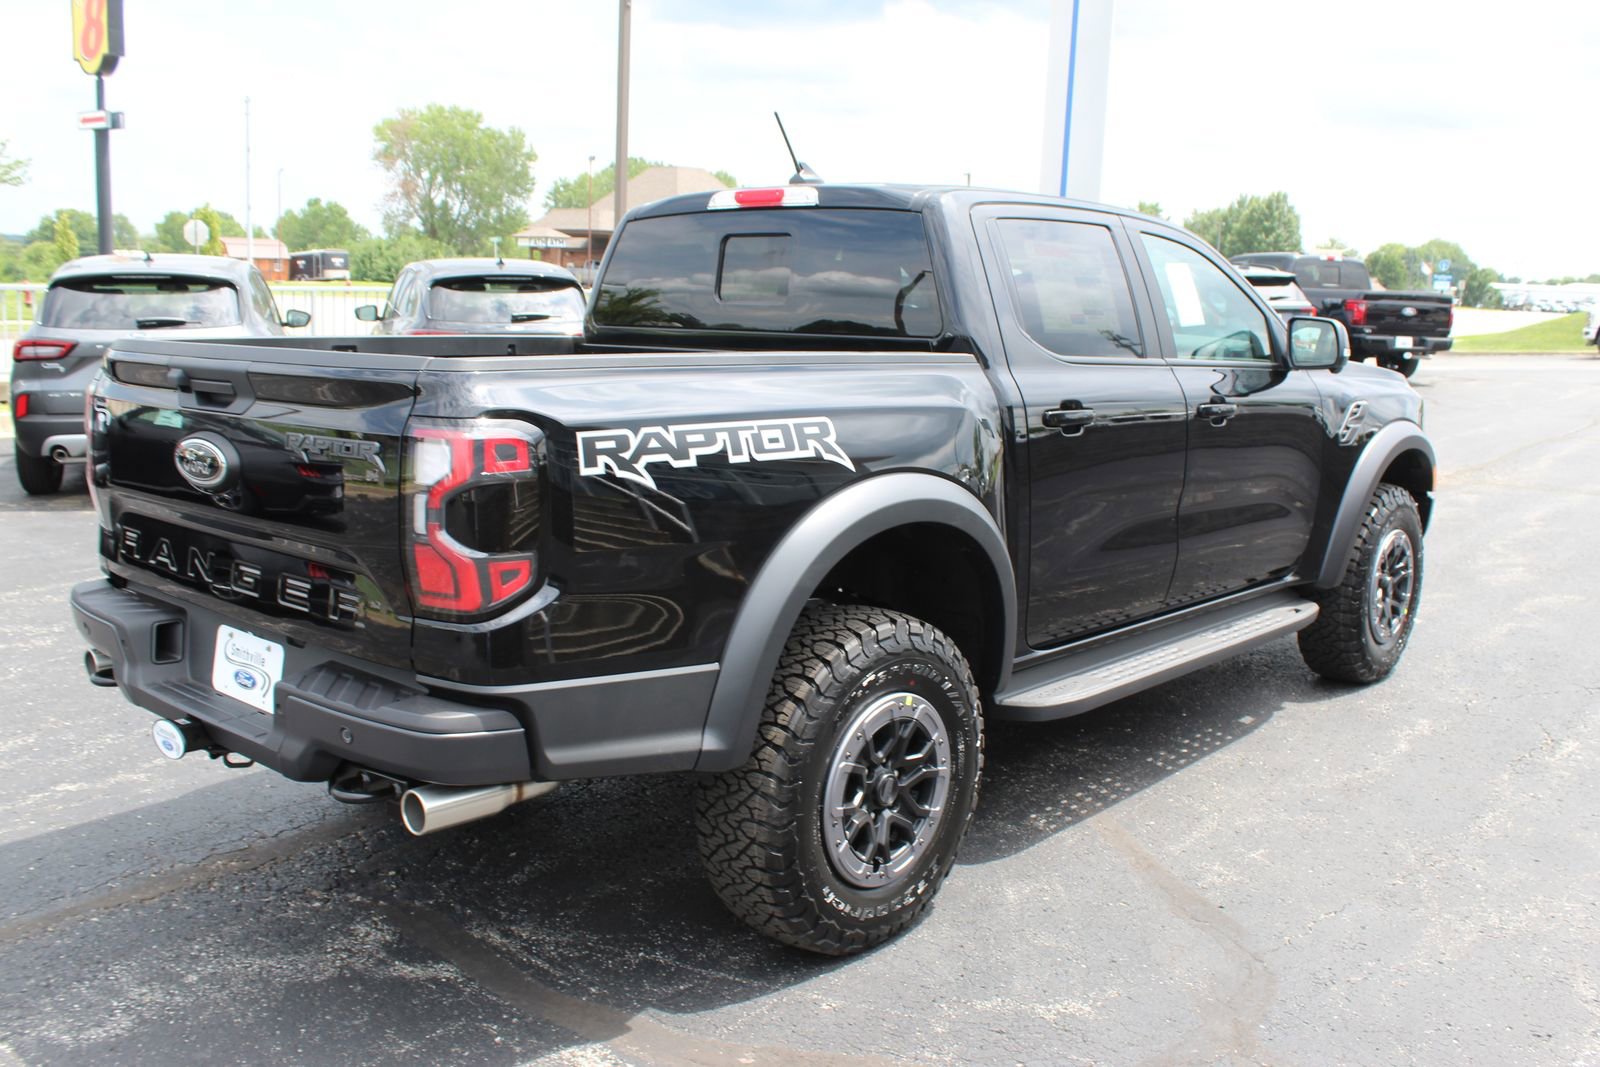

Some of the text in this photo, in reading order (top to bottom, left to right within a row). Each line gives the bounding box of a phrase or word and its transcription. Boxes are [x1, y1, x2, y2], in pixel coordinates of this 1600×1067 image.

[180, 446, 213, 476] Ford
[284, 431, 386, 473] RAPTOR
[576, 416, 856, 490] RAPTOR
[119, 524, 367, 628] RANGER
